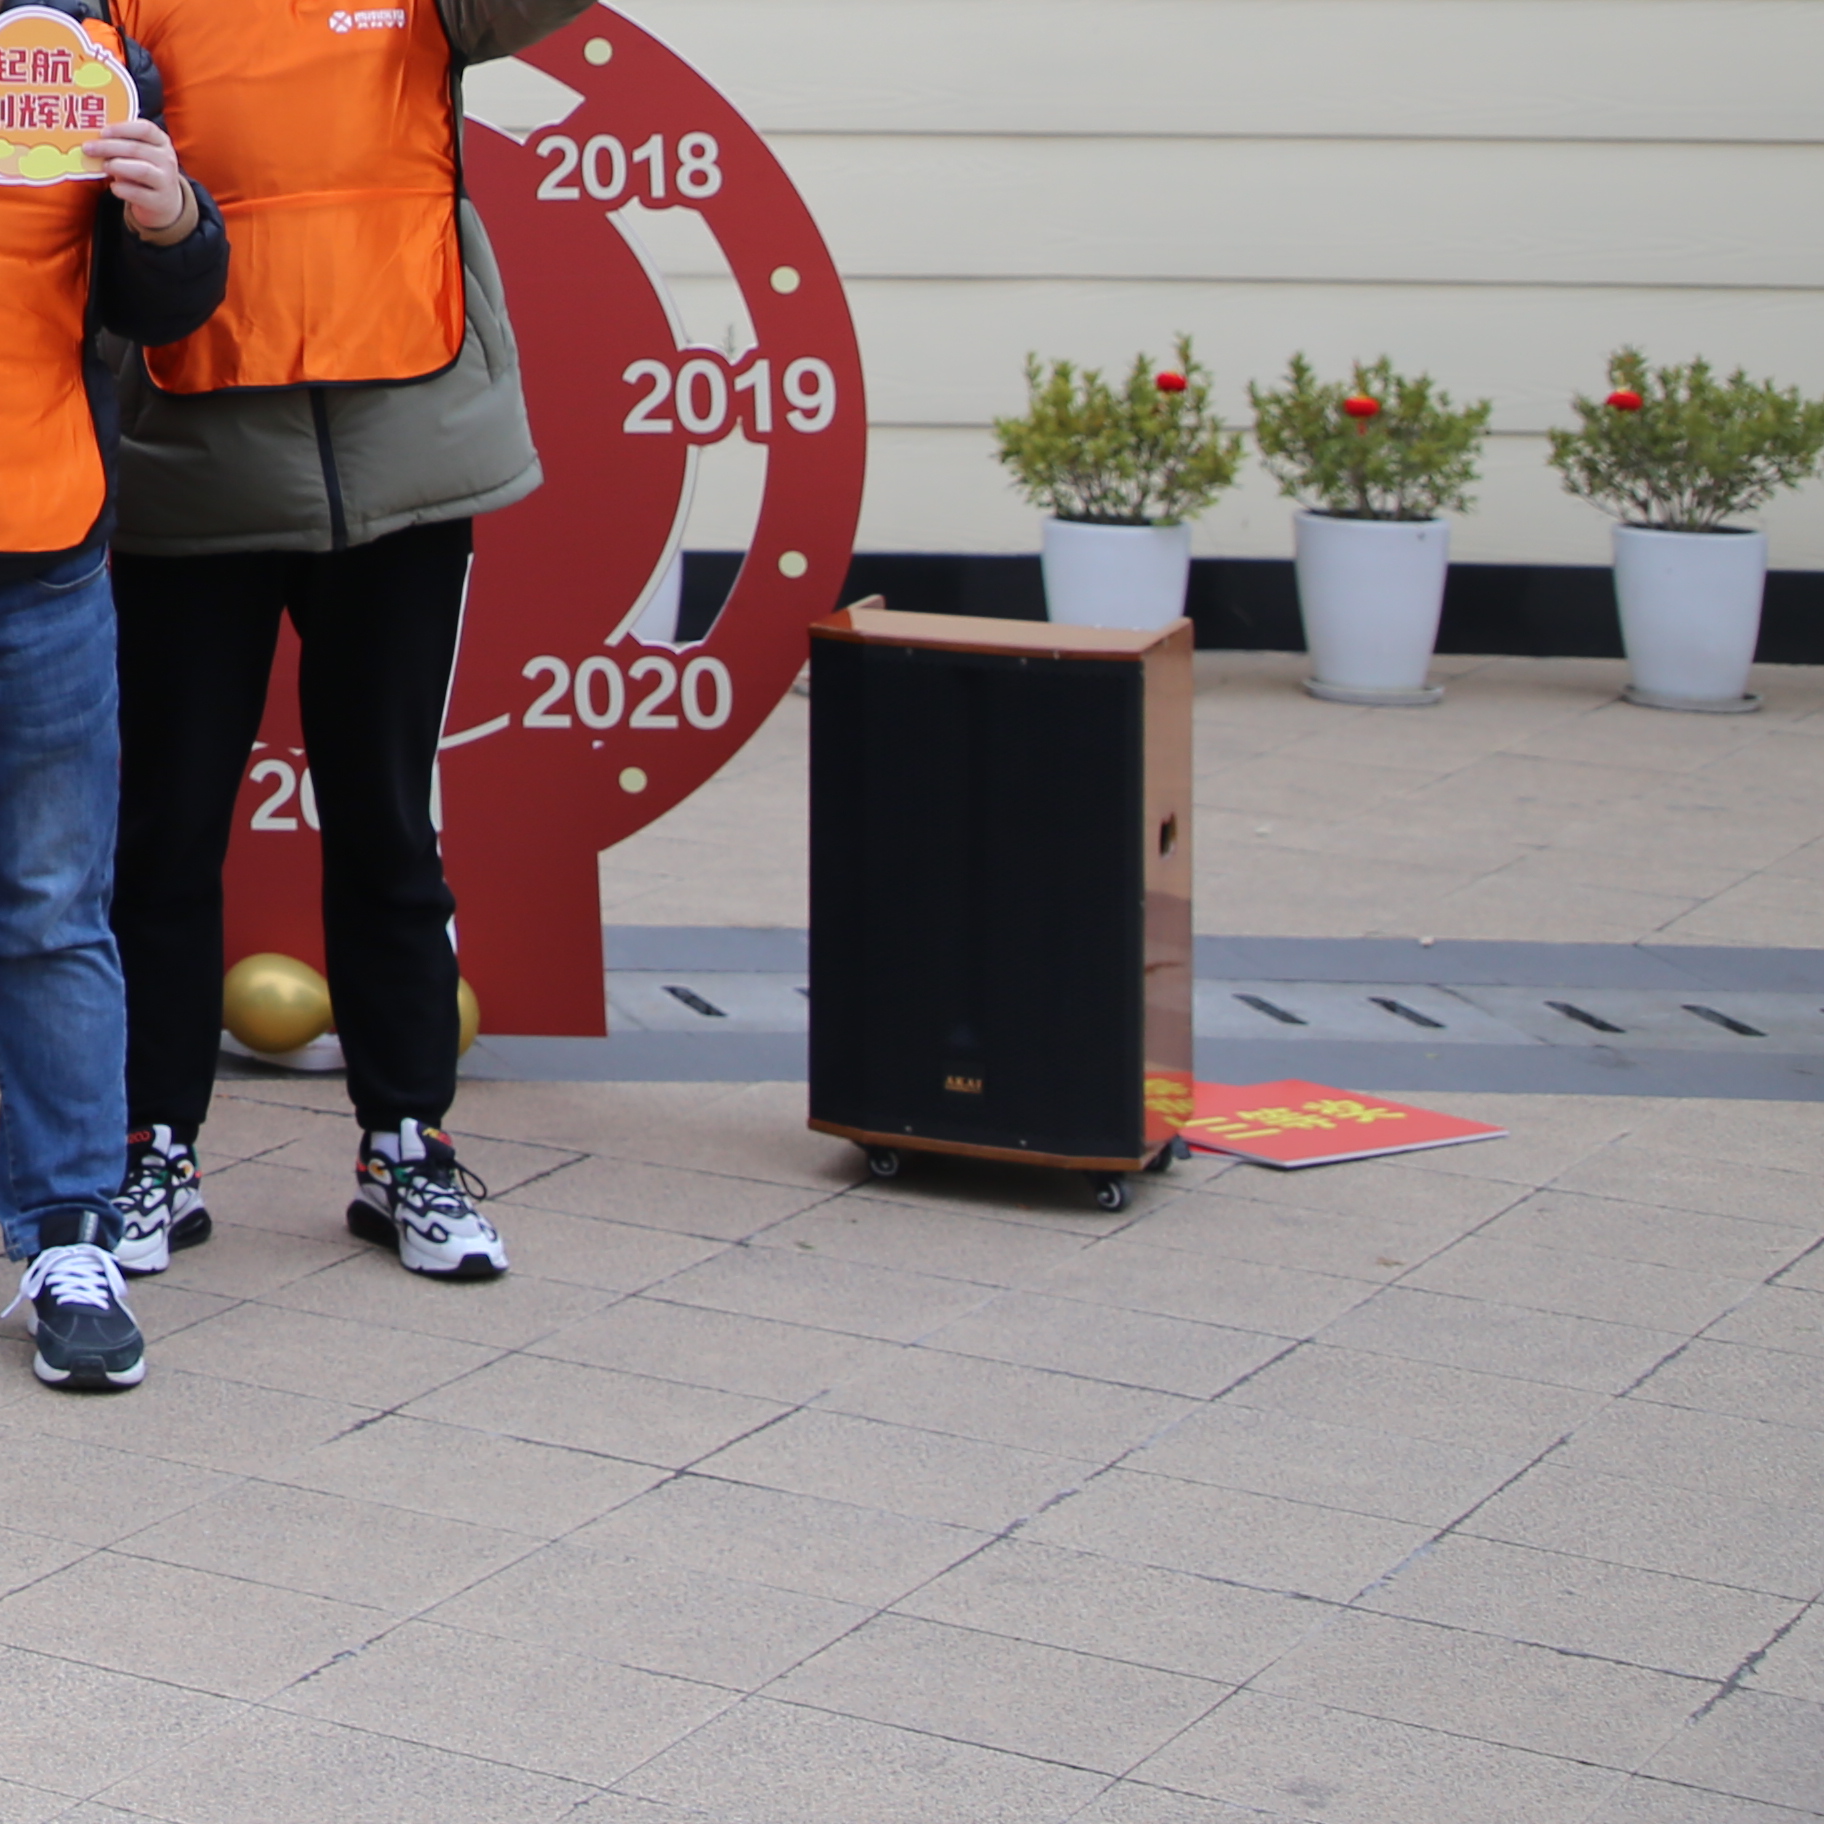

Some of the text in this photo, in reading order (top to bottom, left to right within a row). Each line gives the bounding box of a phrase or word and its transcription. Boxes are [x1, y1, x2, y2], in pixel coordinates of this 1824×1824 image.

[536, 132, 723, 201] 2018
[622, 357, 838, 436] 2019
[521, 655, 734, 730] 2020
